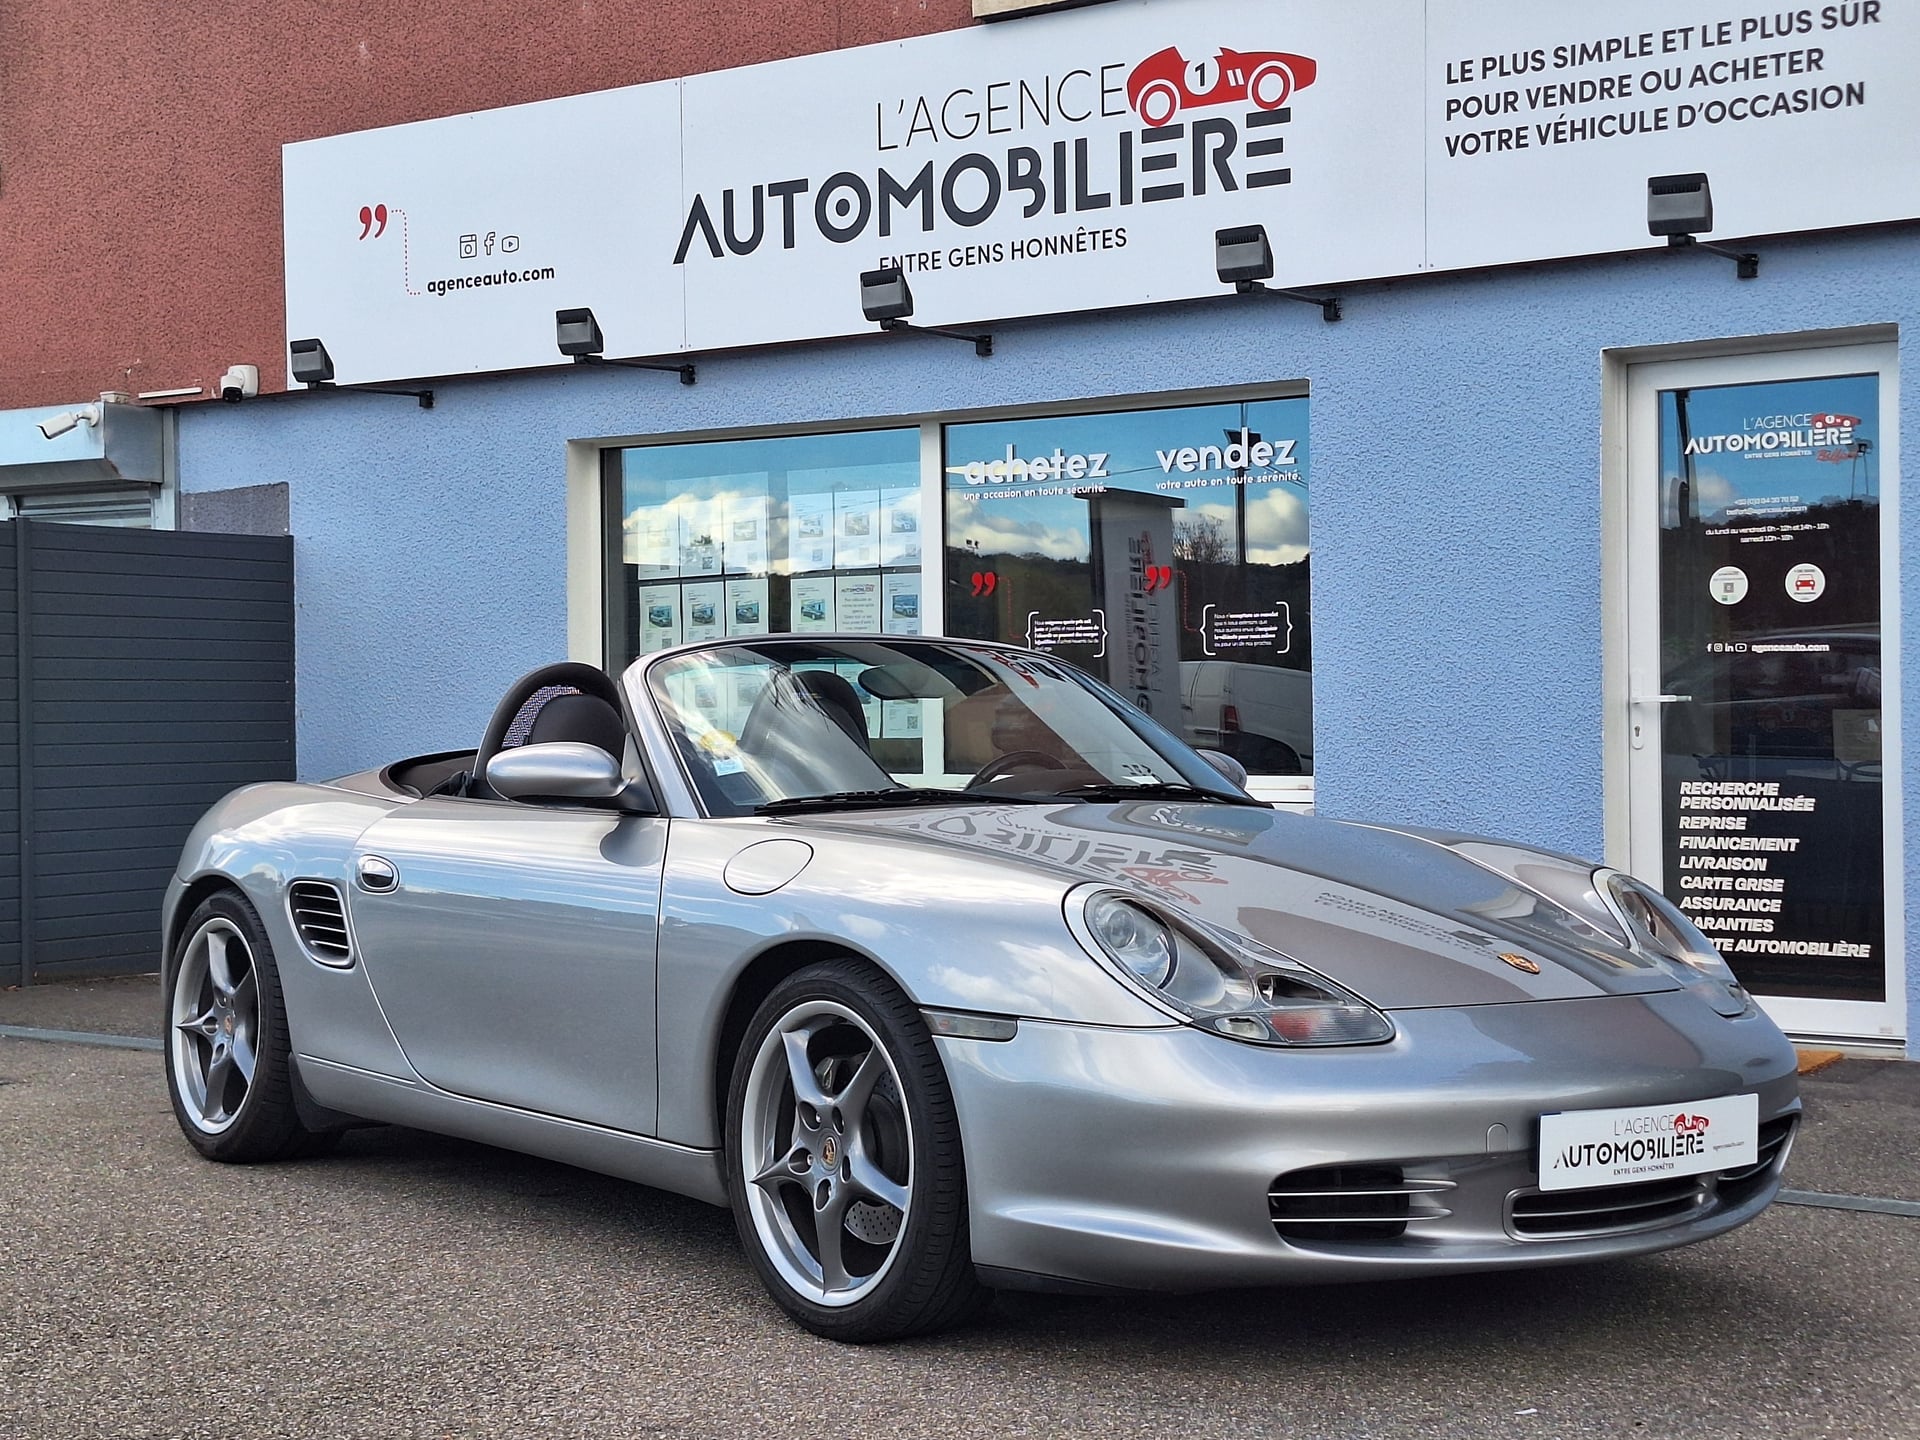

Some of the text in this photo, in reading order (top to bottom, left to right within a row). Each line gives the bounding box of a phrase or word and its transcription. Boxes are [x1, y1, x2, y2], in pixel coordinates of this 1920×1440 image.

[1446, 60, 1474, 84] LE
[1481, 50, 1546, 79] PLUS
[1553, 32, 1653, 68] SIMPLE
[1661, 26, 1694, 54] ET
[1701, 20, 1732, 47] LE
[1741, 8, 1812, 42] PLUS
[1446, 47, 1824, 121] POUR VENDRE OU ACHETER
[877, 63, 1127, 151] L’AGENCE
[1445, 81, 1866, 158] VOTRE VÉHICULE D’OCCASION
[879, 226, 1128, 273] ENTRE GENS HONNÊTES
[427, 267, 555, 297] agenceauto.com
[1156, 427, 1297, 473] vendez
[964, 443, 1109, 485] achetez
[1156, 469, 1302, 490] votre auto en toute sérénité.
[964, 492, 981, 501] une
[983, 487, 1022, 499] occasion
[1025, 489, 1036, 497] en
[1038, 487, 1064, 496] toute
[1680, 782, 1780, 796] RECHERCHE
[1680, 795, 1816, 811] PERSONNALISÉE
[1679, 816, 1747, 830] REPRISE
[1679, 836, 1800, 852] FINANCEMENT
[1679, 856, 1768, 872] LIVRAISON
[1680, 876, 1785, 893] CARTE GRISE
[1680, 896, 1782, 913] ASSURANCE
[1687, 916, 1775, 933] ARANTIES
[1735, 938, 1872, 958] AUTOMOBILIÈRE
